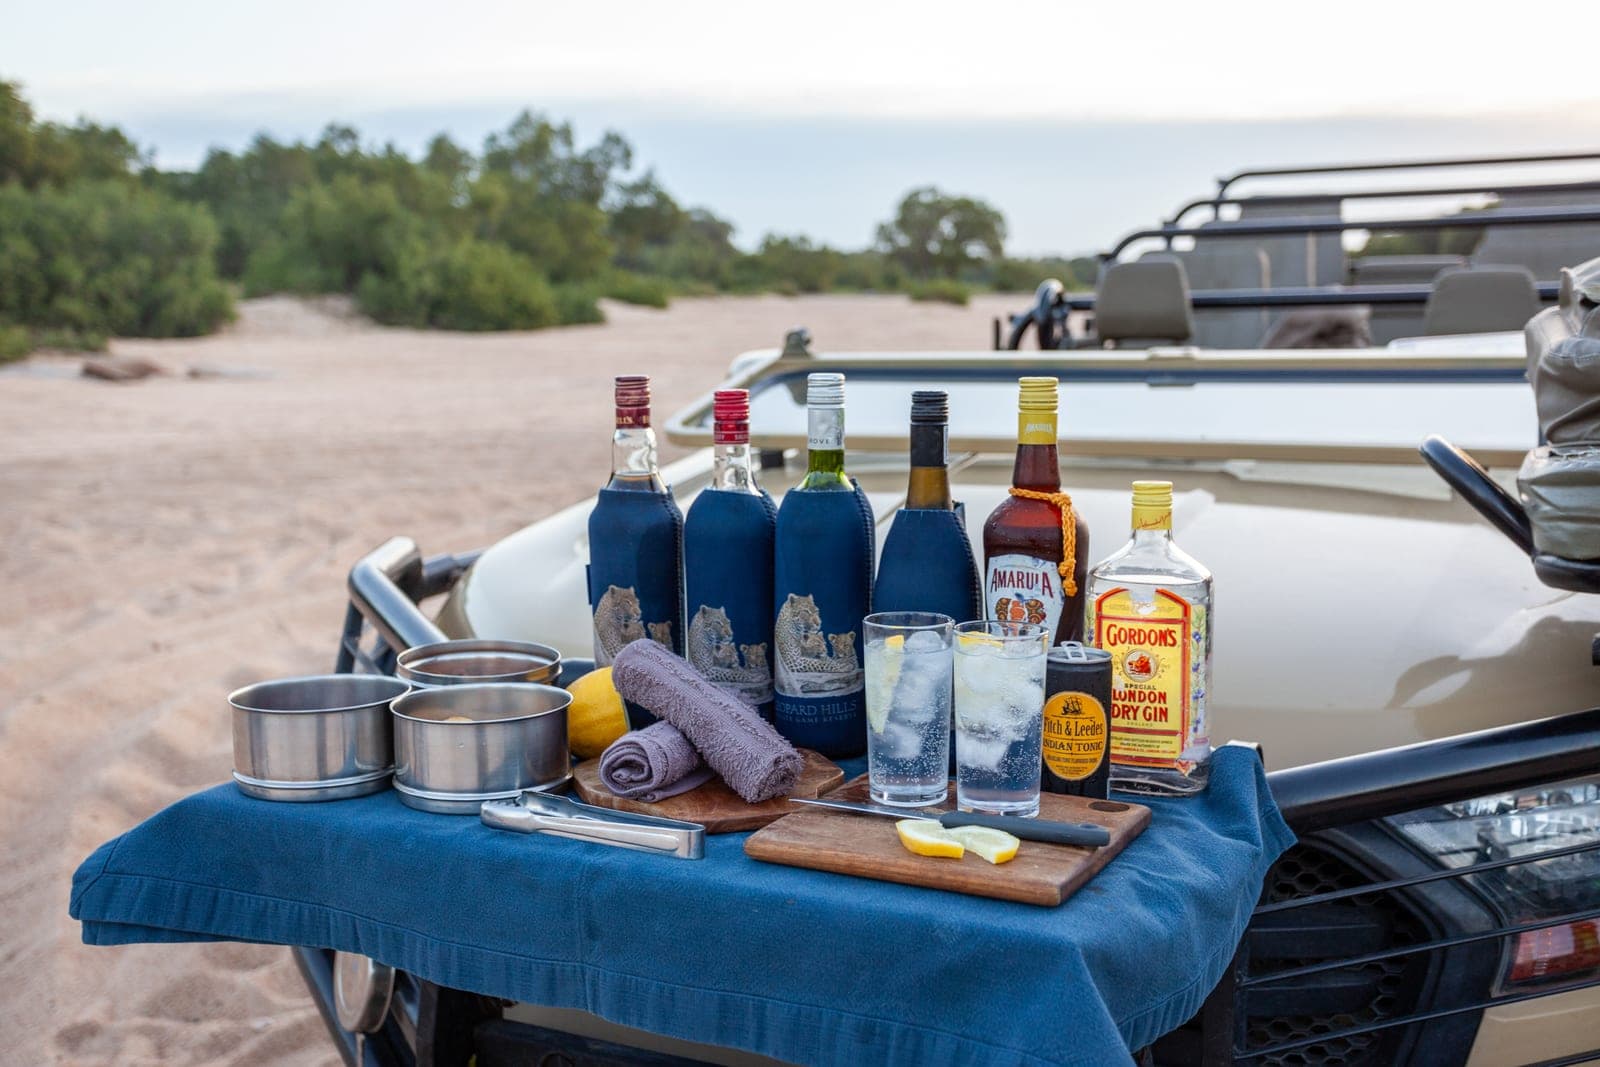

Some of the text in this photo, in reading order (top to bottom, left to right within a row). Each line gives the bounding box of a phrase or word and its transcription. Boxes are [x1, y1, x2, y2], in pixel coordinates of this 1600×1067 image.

[1106, 623, 1178, 647] GORDON'S
[1112, 688, 1167, 705] LONDON
[821, 699, 857, 715] HILLS
[1111, 703, 1169, 723] DRY GIN
[1064, 720, 1073, 737] &
[1074, 719, 1104, 737] Leedes
[1075, 741, 1104, 752] TONIC
